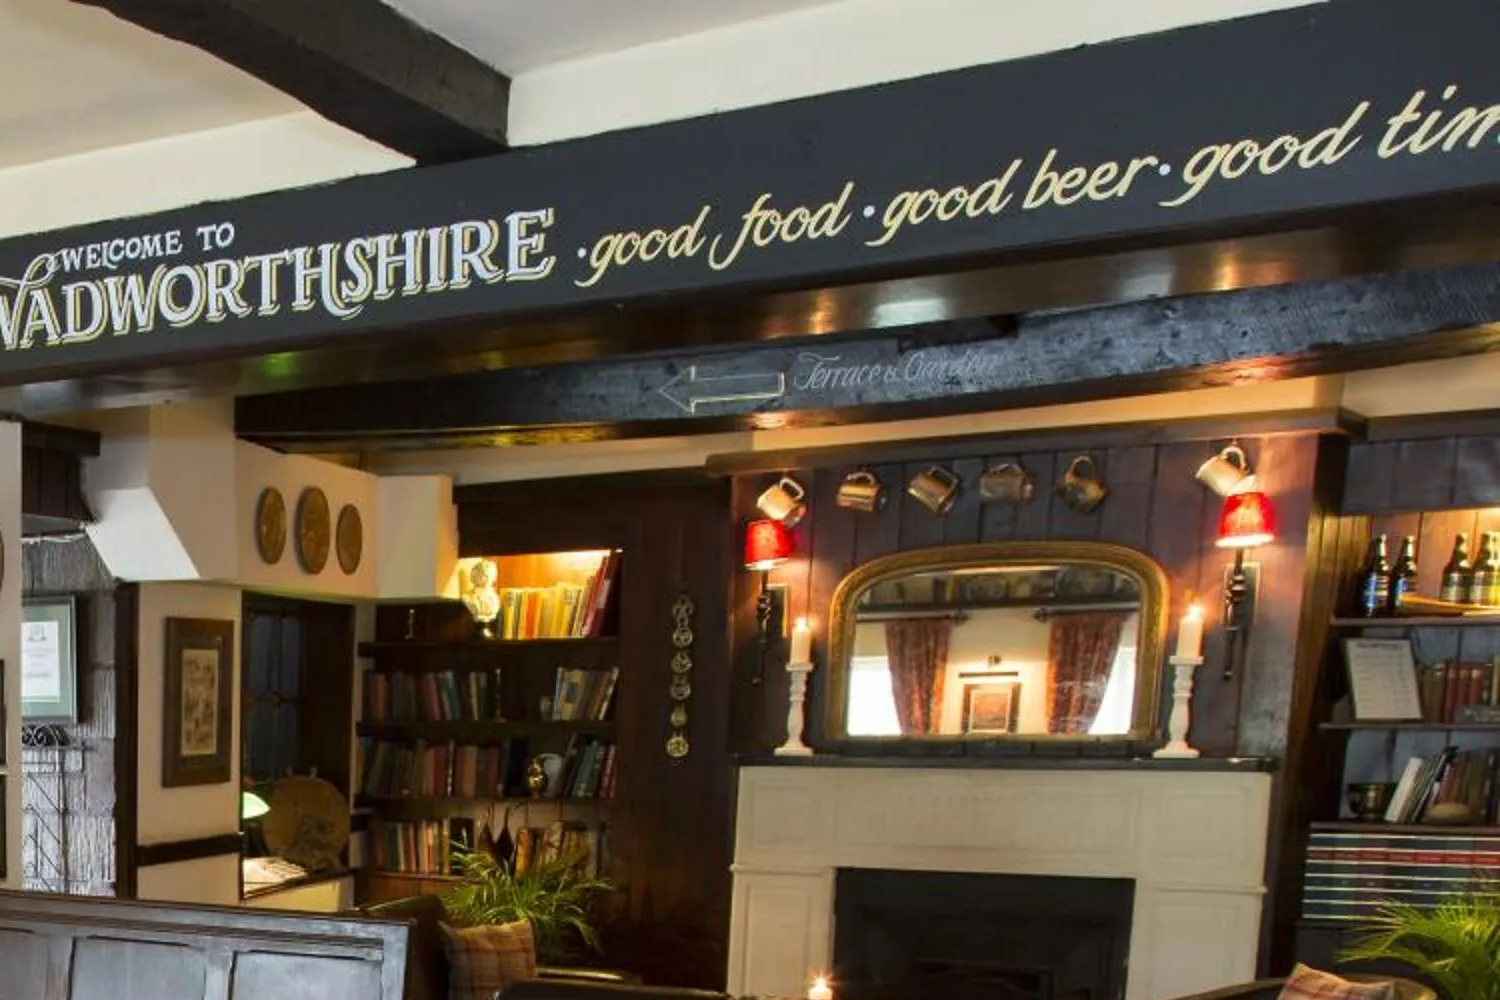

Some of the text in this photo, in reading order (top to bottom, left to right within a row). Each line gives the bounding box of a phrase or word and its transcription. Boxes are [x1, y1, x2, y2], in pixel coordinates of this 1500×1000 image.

[574, 205, 711, 287] good
[709, 182, 855, 270] food
[864, 158, 1023, 247] good
[1022, 148, 1159, 209] beer
[1157, 101, 1371, 207] good
[58, 221, 236, 272] WELCOME TO
[793, 352, 881, 390] Terrace
